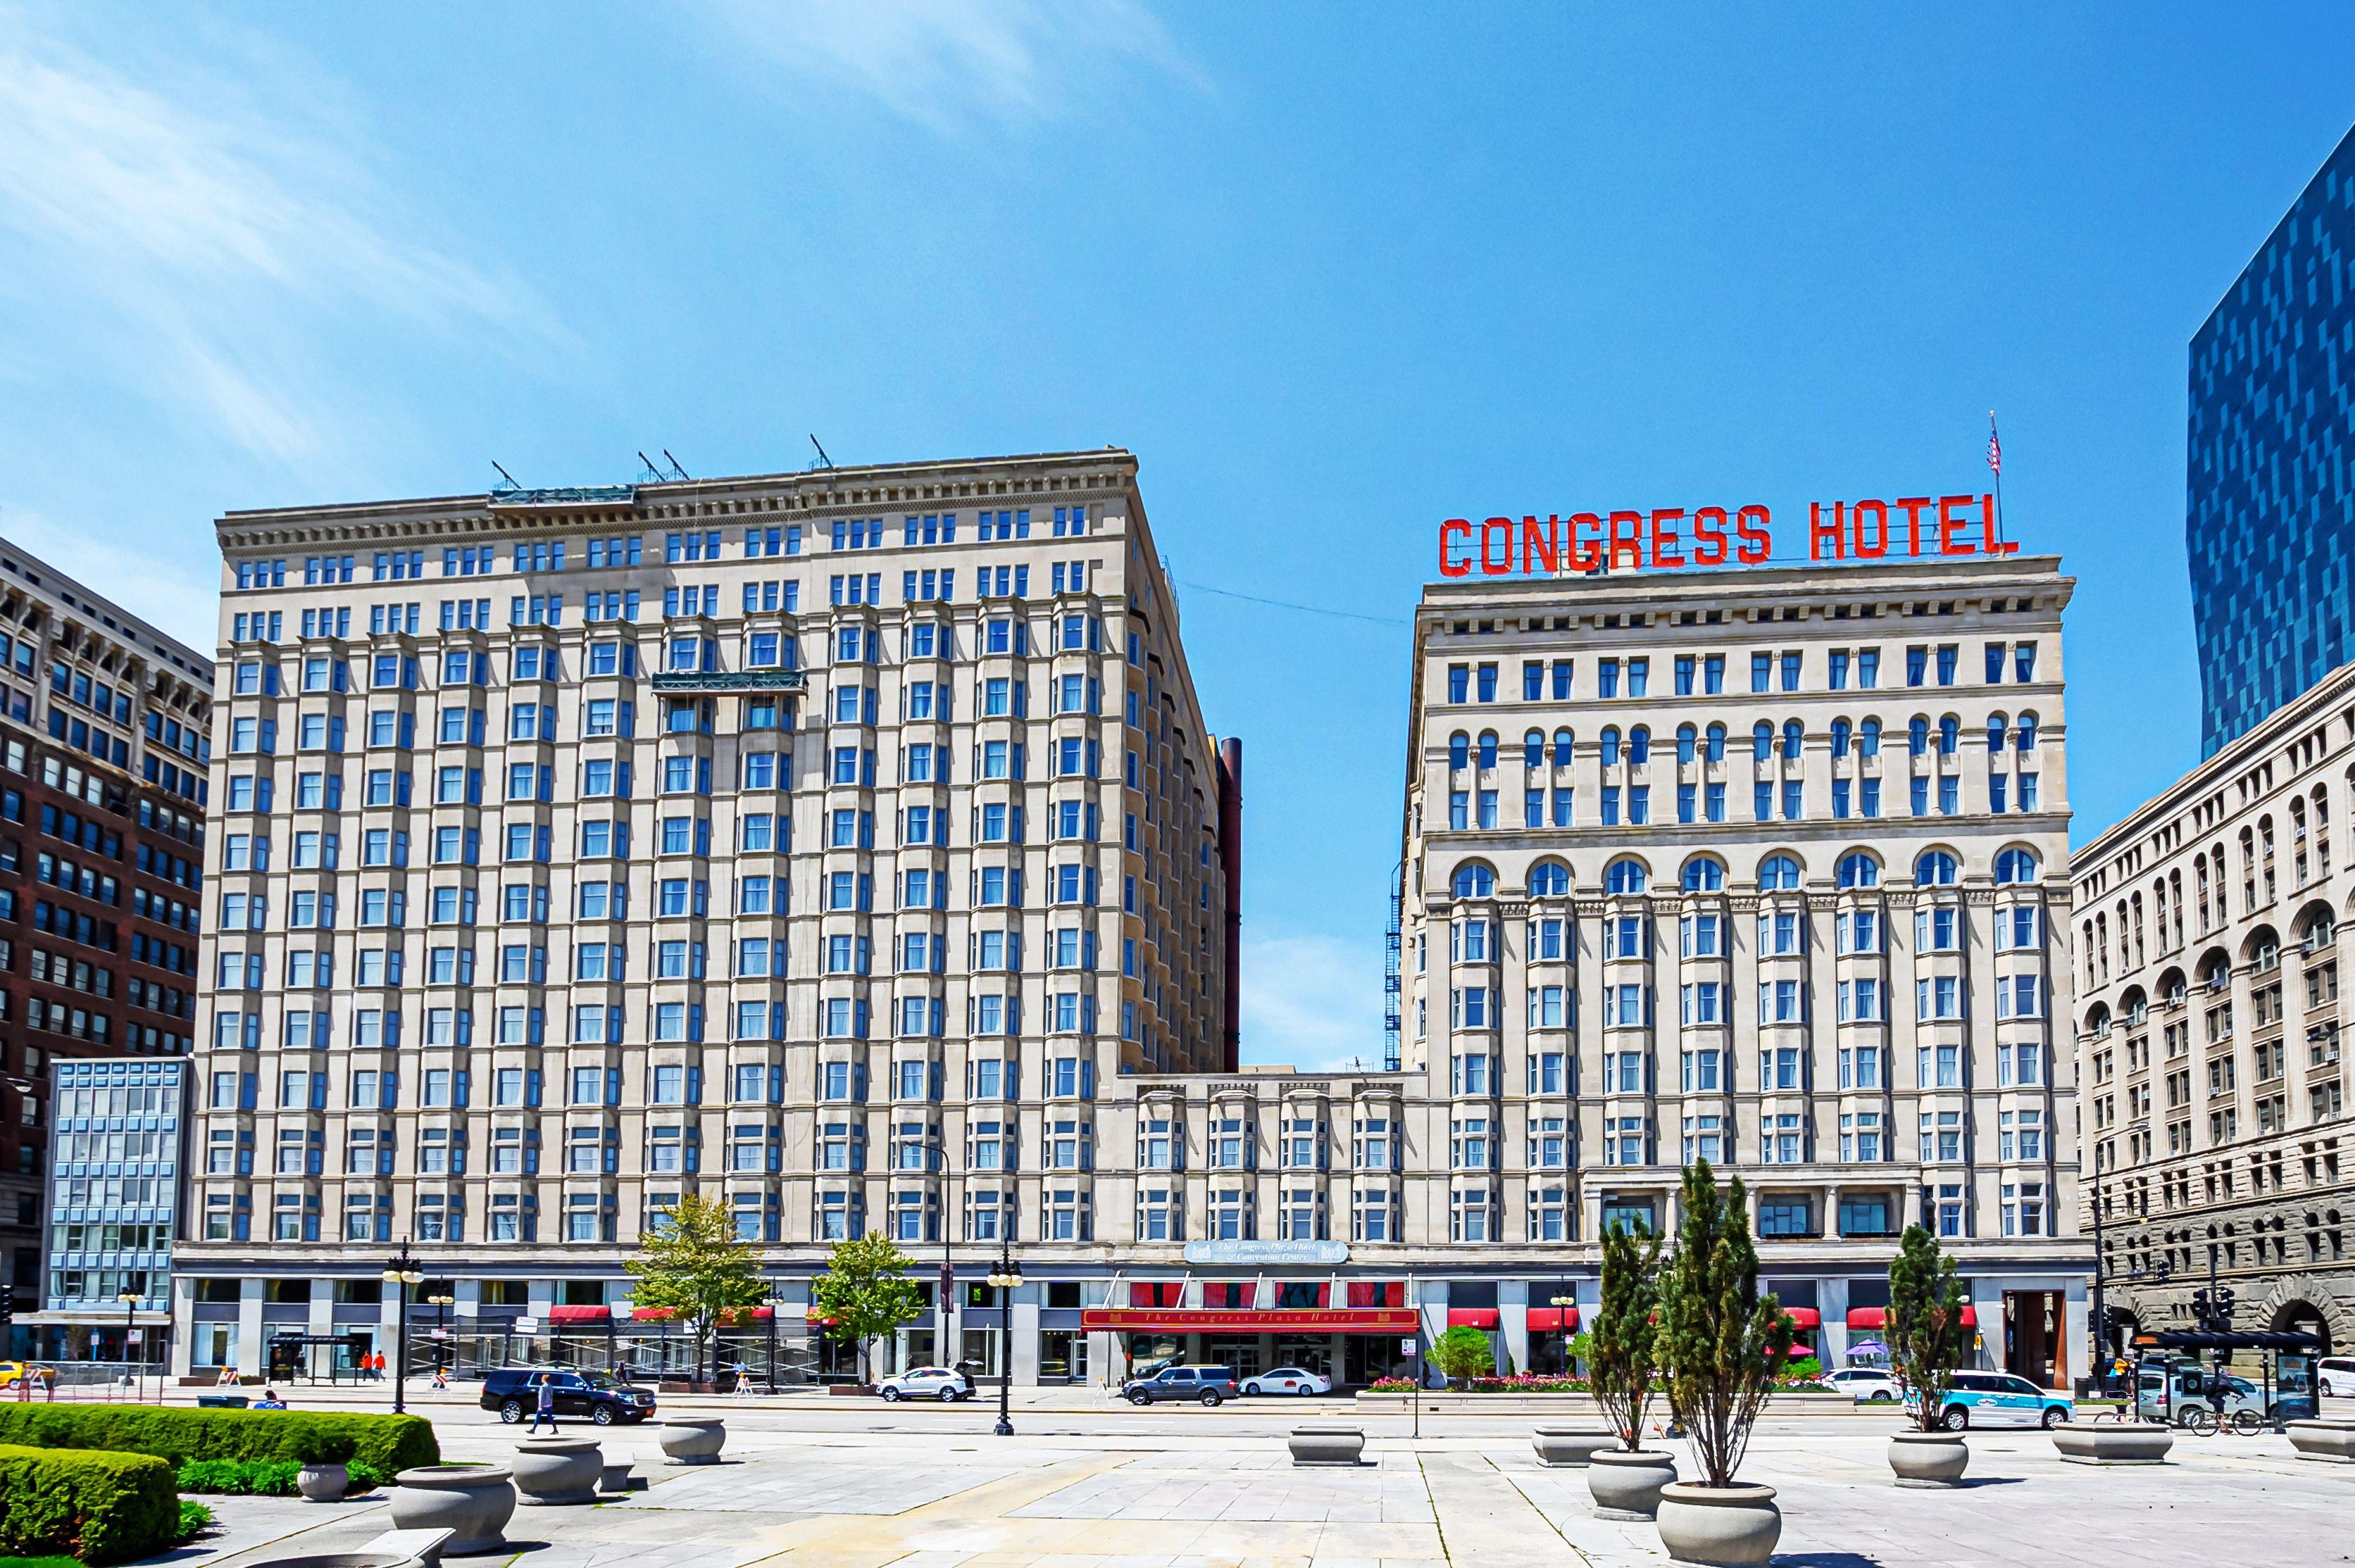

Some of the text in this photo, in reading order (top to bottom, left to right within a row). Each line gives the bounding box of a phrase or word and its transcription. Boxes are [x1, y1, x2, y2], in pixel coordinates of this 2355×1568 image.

[1439, 494, 2019, 577] CONGRESS HOTEL
[1218, 1242, 1316, 1253] The Congress Plaza Hotel
[1236, 1253, 1282, 1261] Convention
[1282, 1253, 1307, 1261] Center
[1179, 1313, 1249, 1323] Congress
[1311, 1312, 1354, 1321] Hotel
